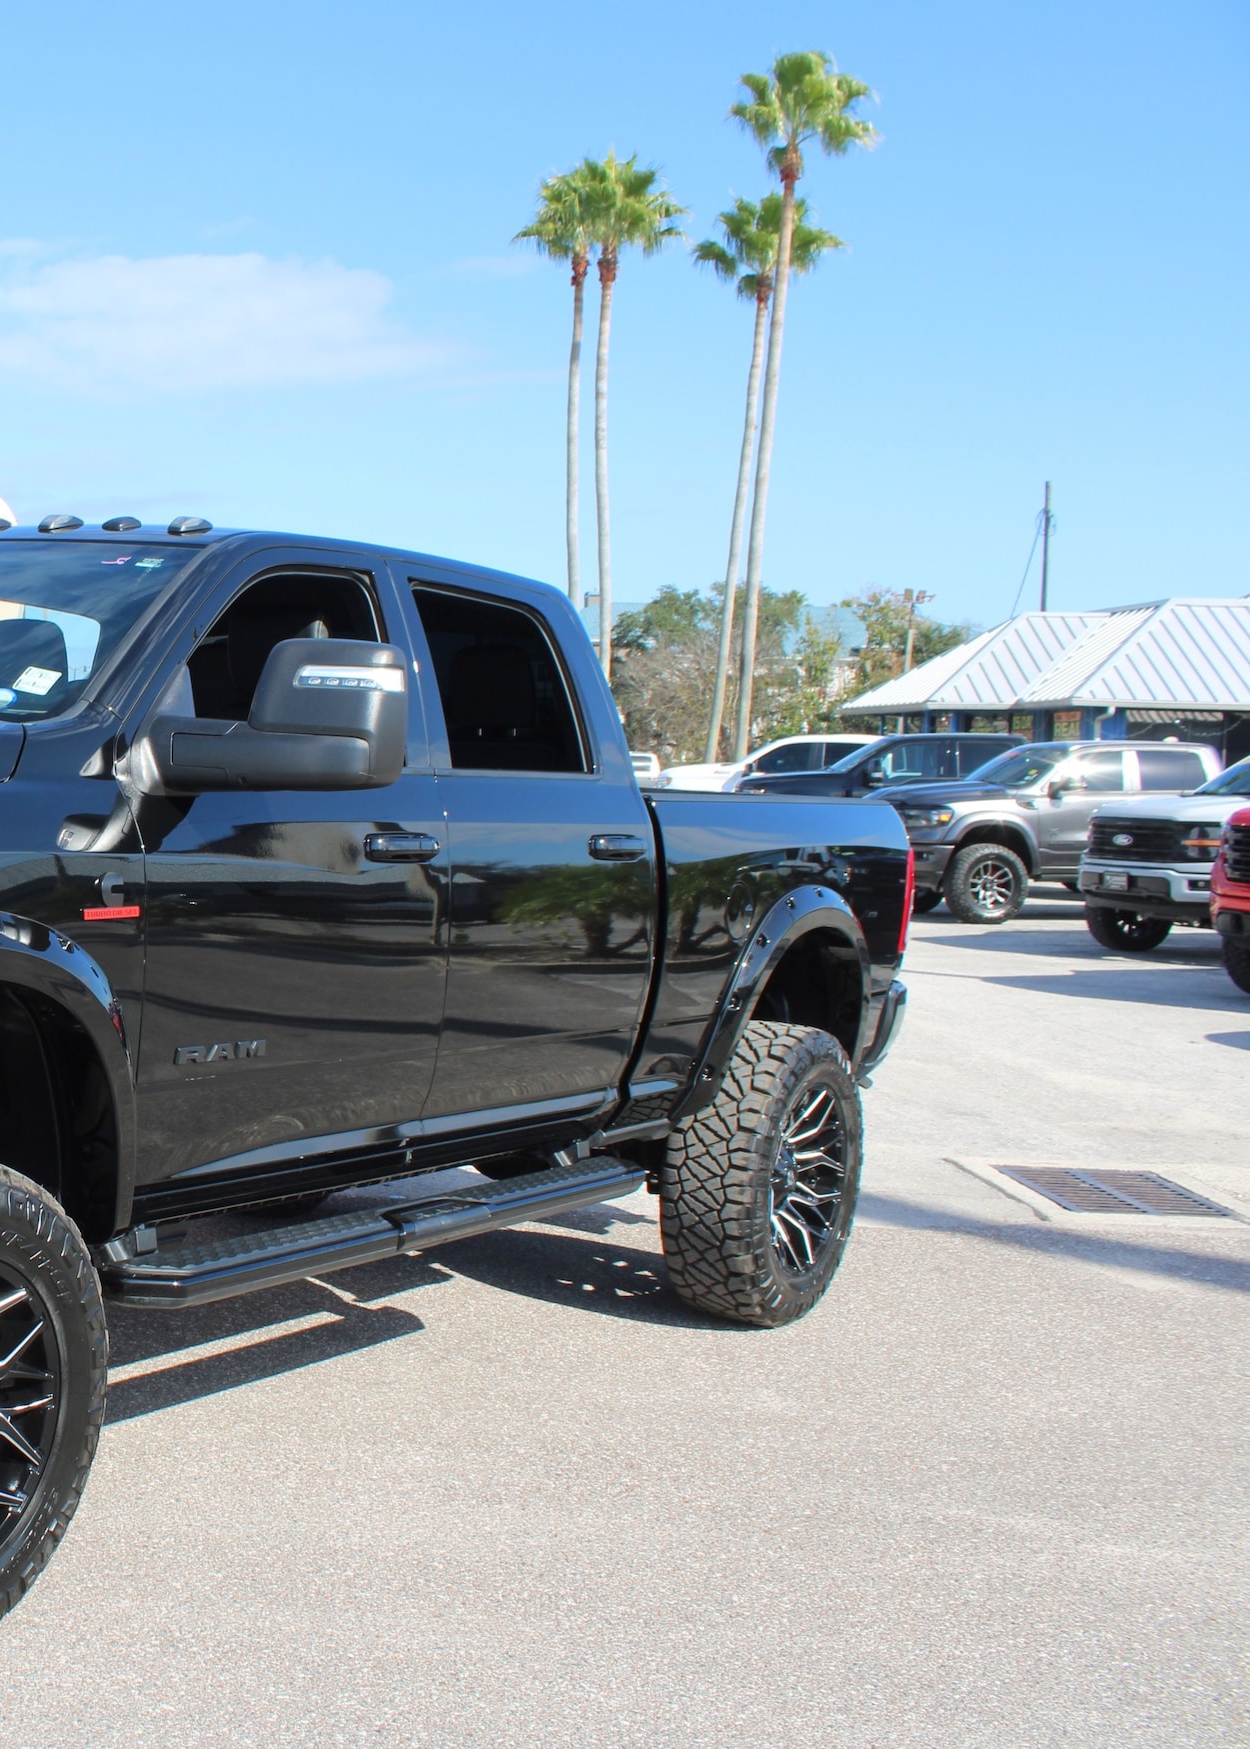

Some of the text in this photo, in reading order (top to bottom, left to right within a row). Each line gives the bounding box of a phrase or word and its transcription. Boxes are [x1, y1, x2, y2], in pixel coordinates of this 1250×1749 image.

[86, 908, 138, 918] TURBO DIESEL
[173, 1039, 267, 1065] RAM
